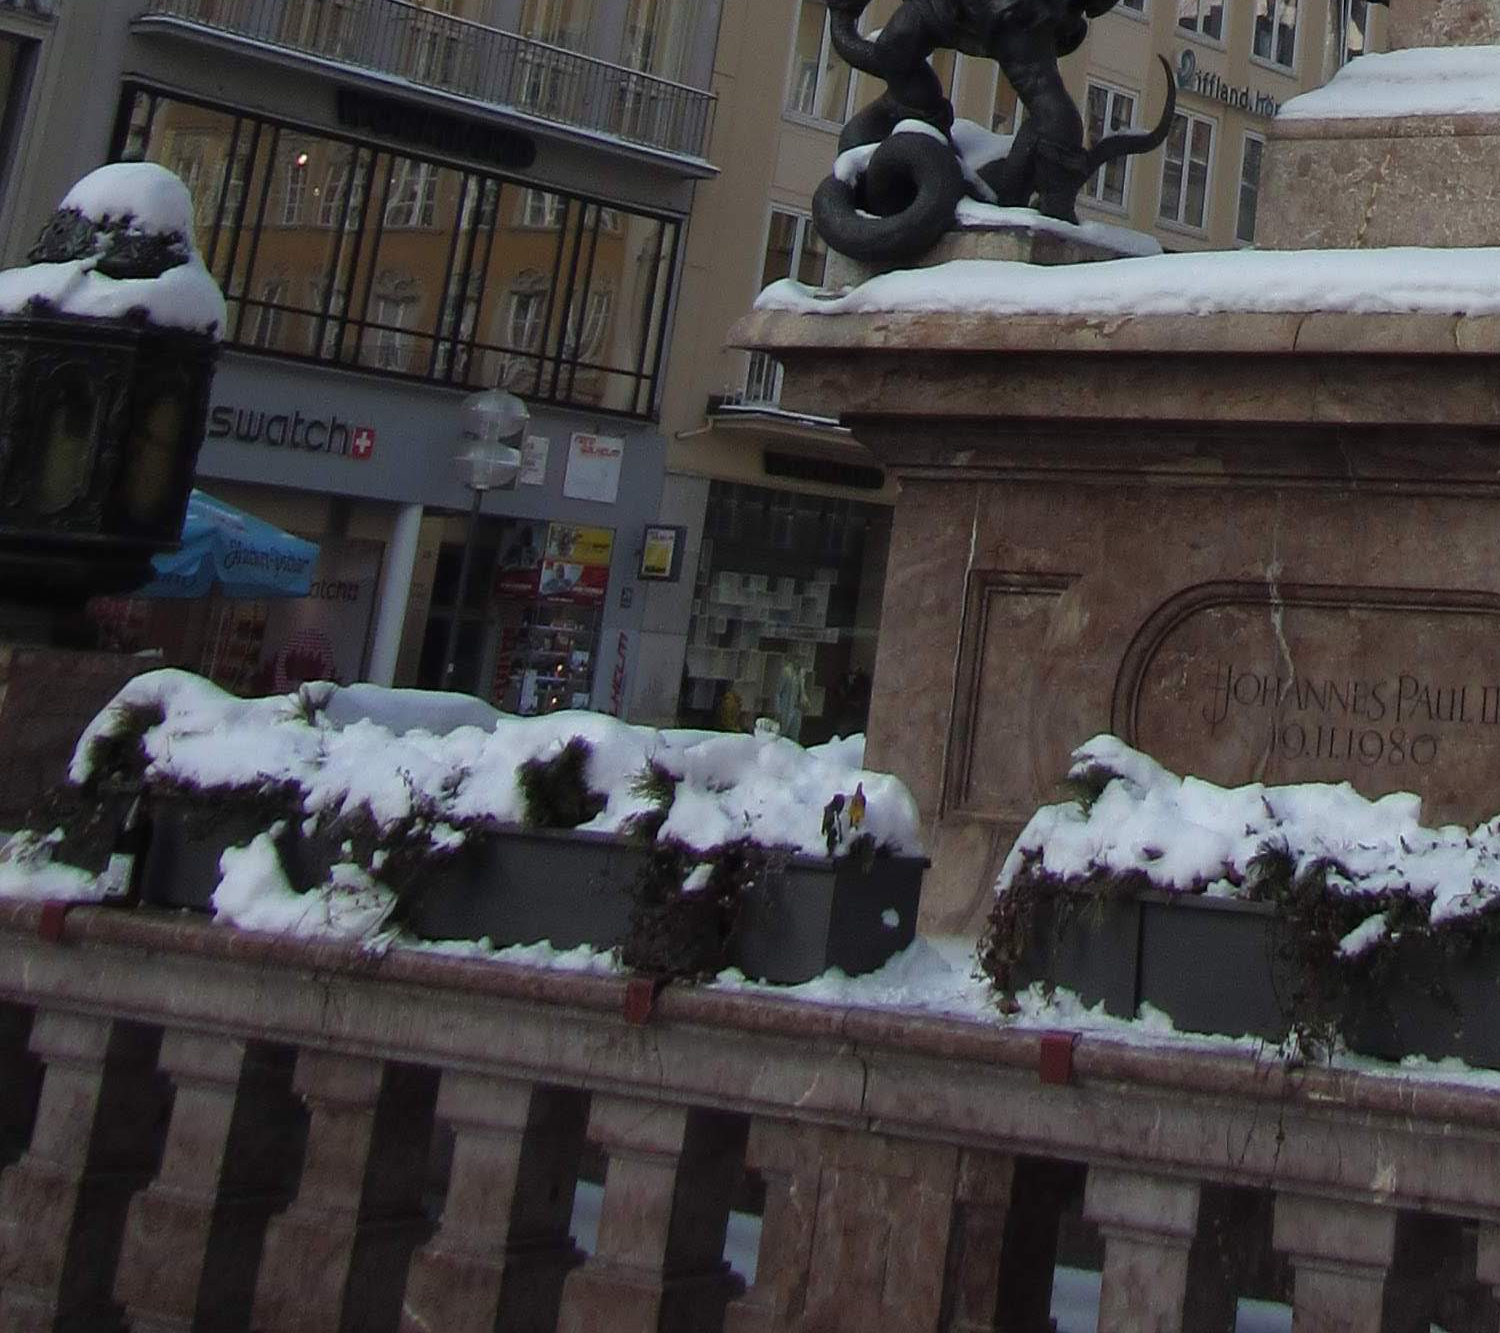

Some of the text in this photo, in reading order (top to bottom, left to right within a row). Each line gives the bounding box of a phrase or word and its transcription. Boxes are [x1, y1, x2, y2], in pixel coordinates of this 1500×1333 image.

[207, 405, 349, 456] swatch
[1202, 664, 1387, 727] JOHANNES
[1396, 674, 1474, 724] PAUL
[1270, 722, 1439, 767] 19.11.1980
